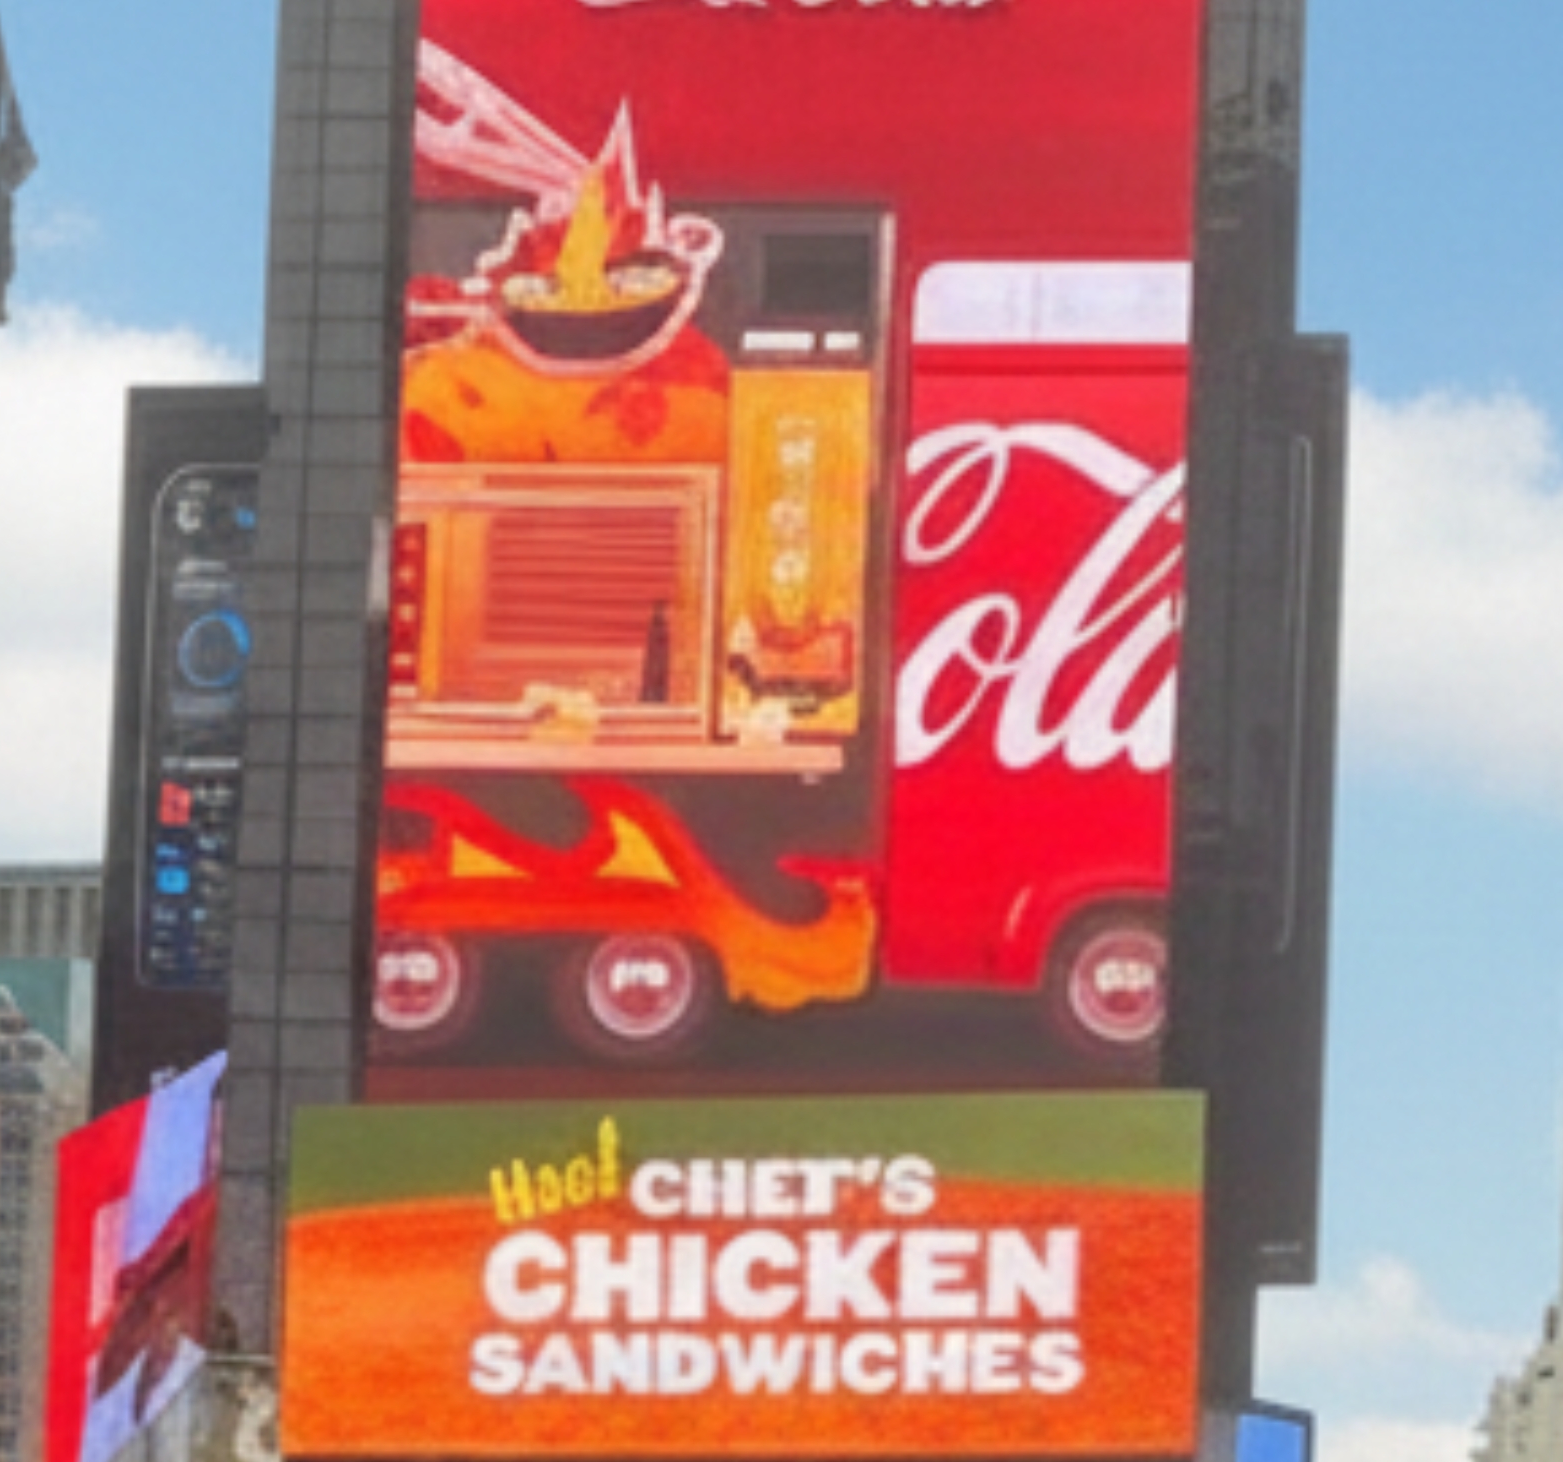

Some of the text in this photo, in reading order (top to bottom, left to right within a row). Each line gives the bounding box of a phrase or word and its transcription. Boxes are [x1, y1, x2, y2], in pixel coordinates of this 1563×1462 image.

[629, 1154, 937, 1218] CHET'S
[482, 1228, 1082, 1322] CHICKEN
[468, 1331, 1085, 1394] SANDWICHES
